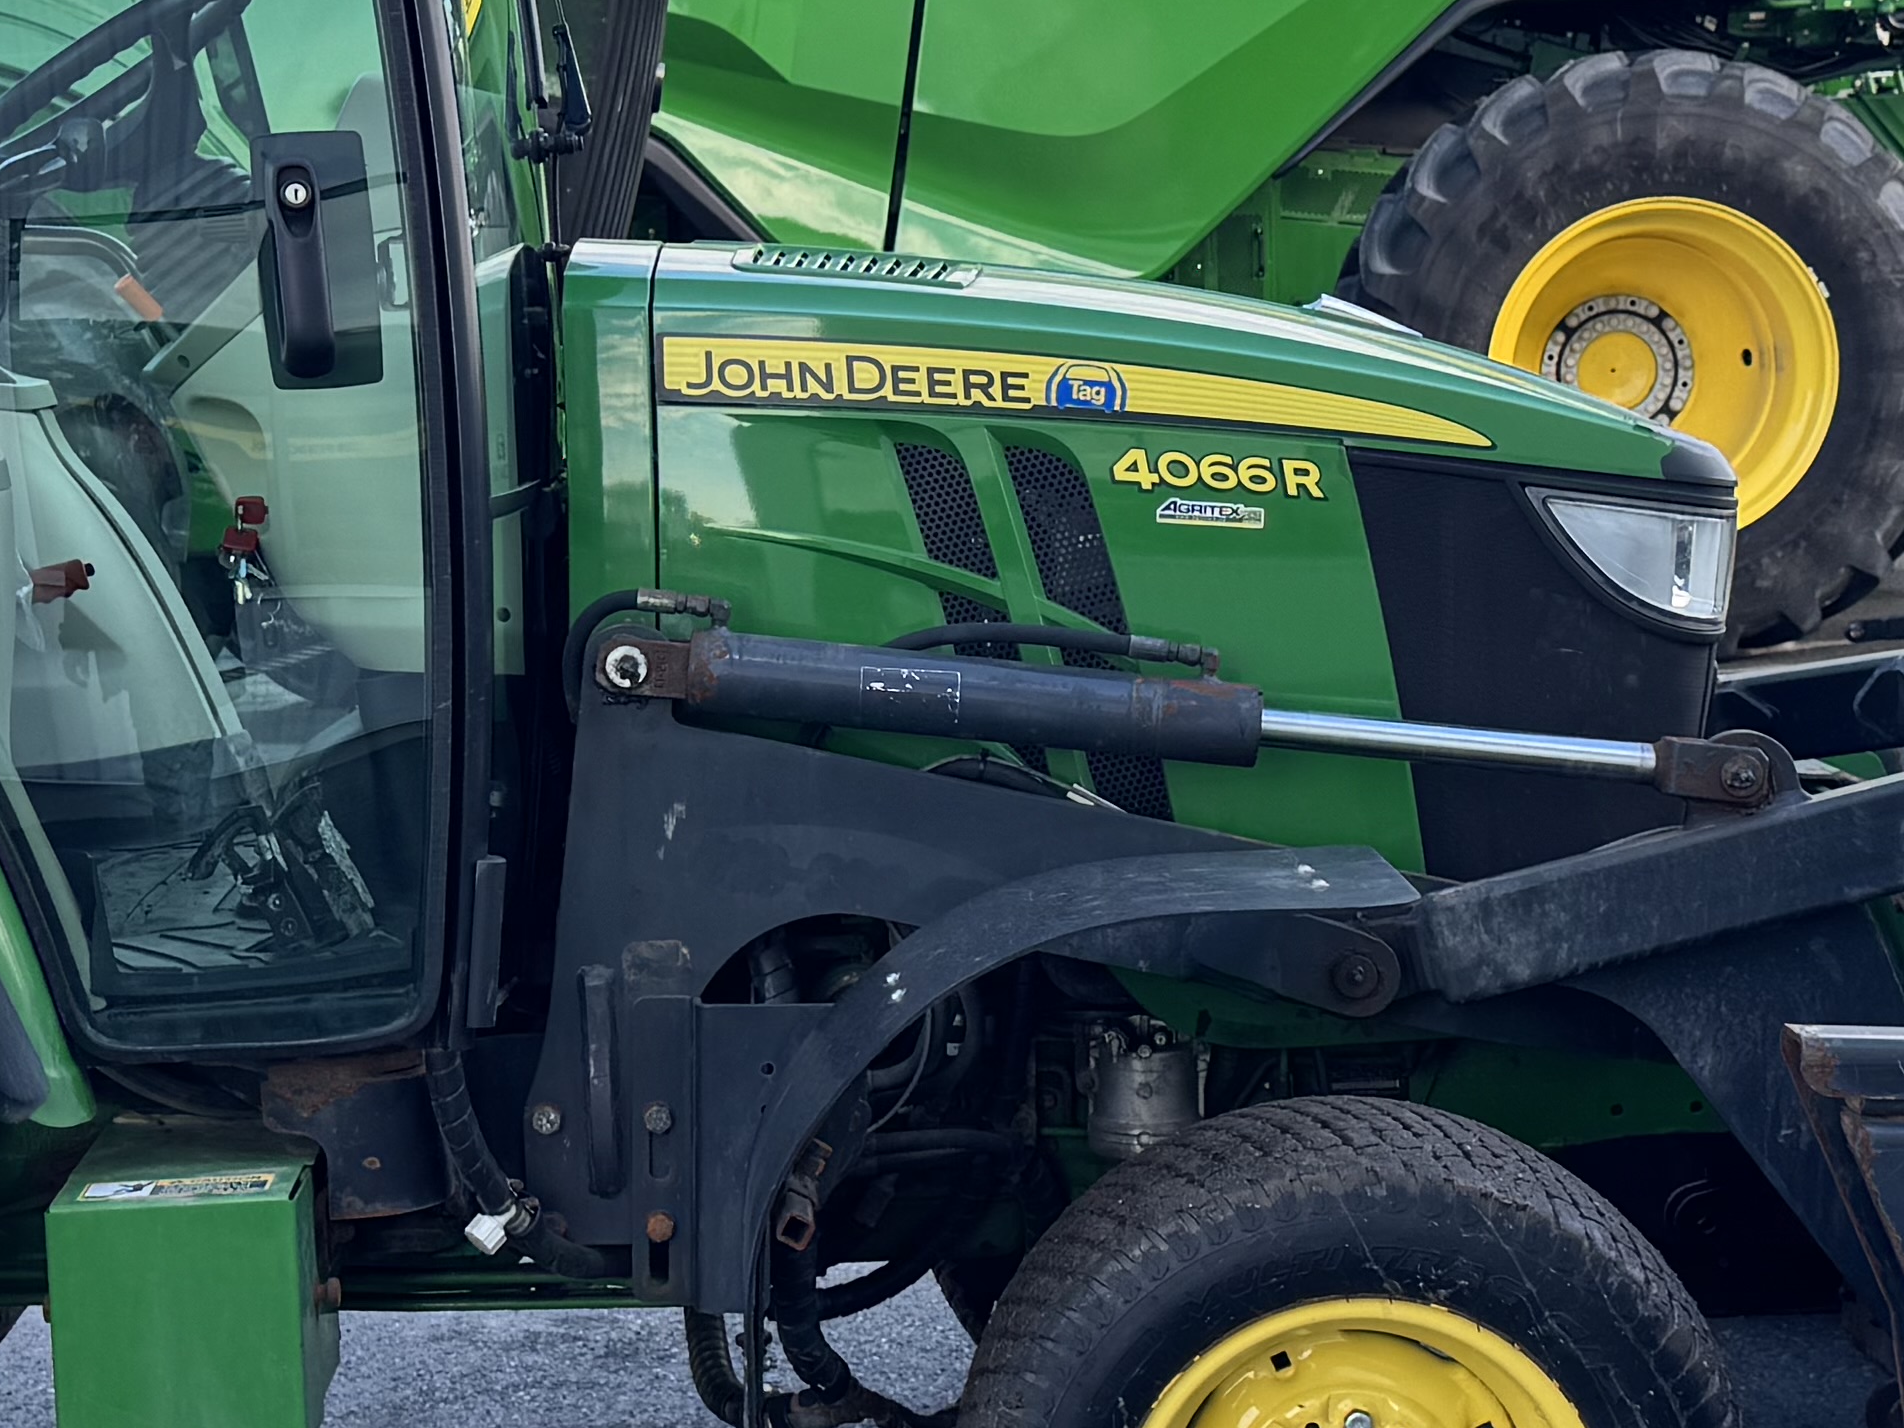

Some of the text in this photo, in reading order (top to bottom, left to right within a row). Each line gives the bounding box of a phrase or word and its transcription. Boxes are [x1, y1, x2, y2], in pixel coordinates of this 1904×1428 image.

[684, 349, 1033, 406] JOHN DEERE
[1067, 378, 1105, 406] Tag
[1160, 500, 1241, 517] AGRITEX
